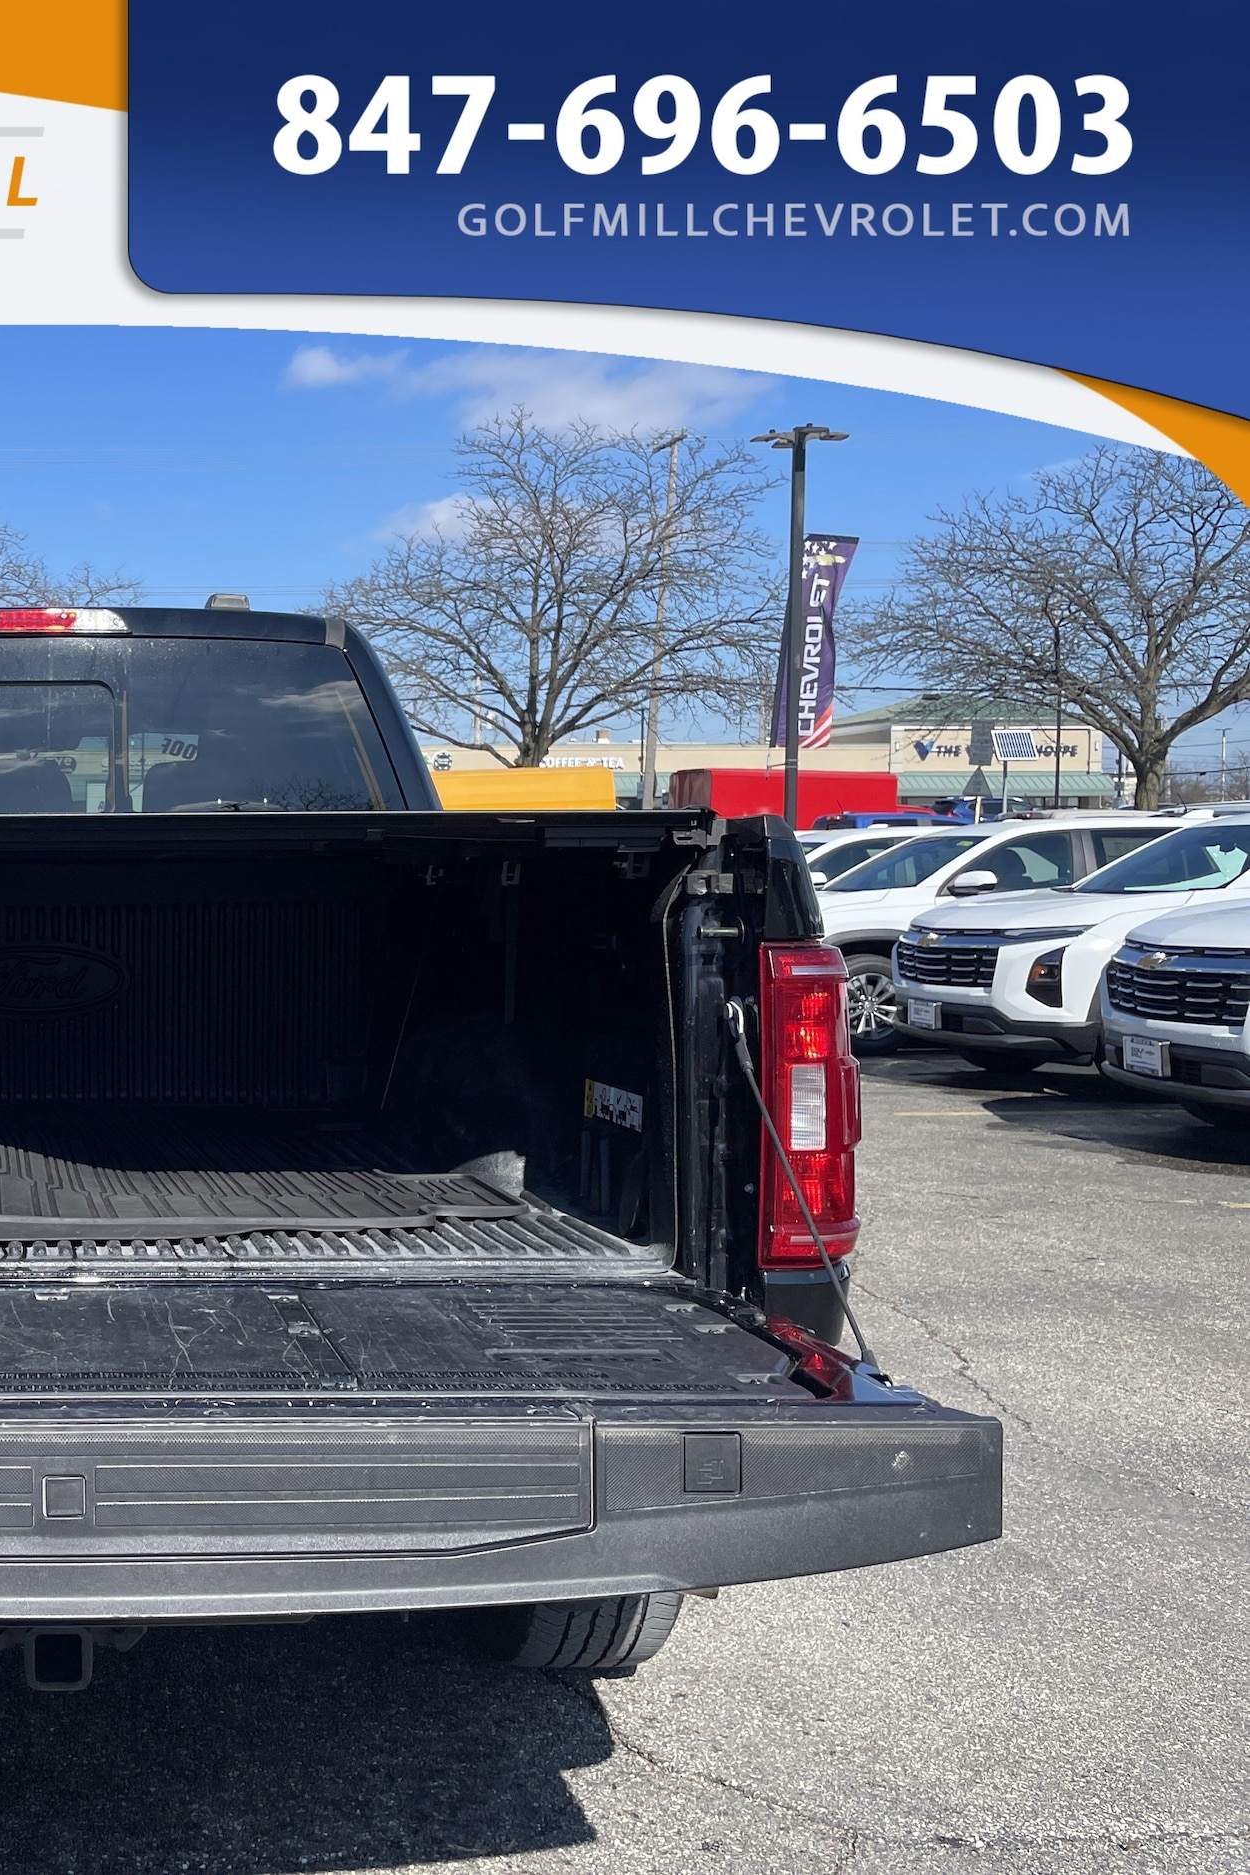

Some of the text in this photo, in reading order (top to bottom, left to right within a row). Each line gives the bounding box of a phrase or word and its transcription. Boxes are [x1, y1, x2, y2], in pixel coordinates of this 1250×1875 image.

[797, 573, 831, 737] CHEVROLET
[936, 745, 962, 758] THE
[602, 757, 625, 769] TEA
